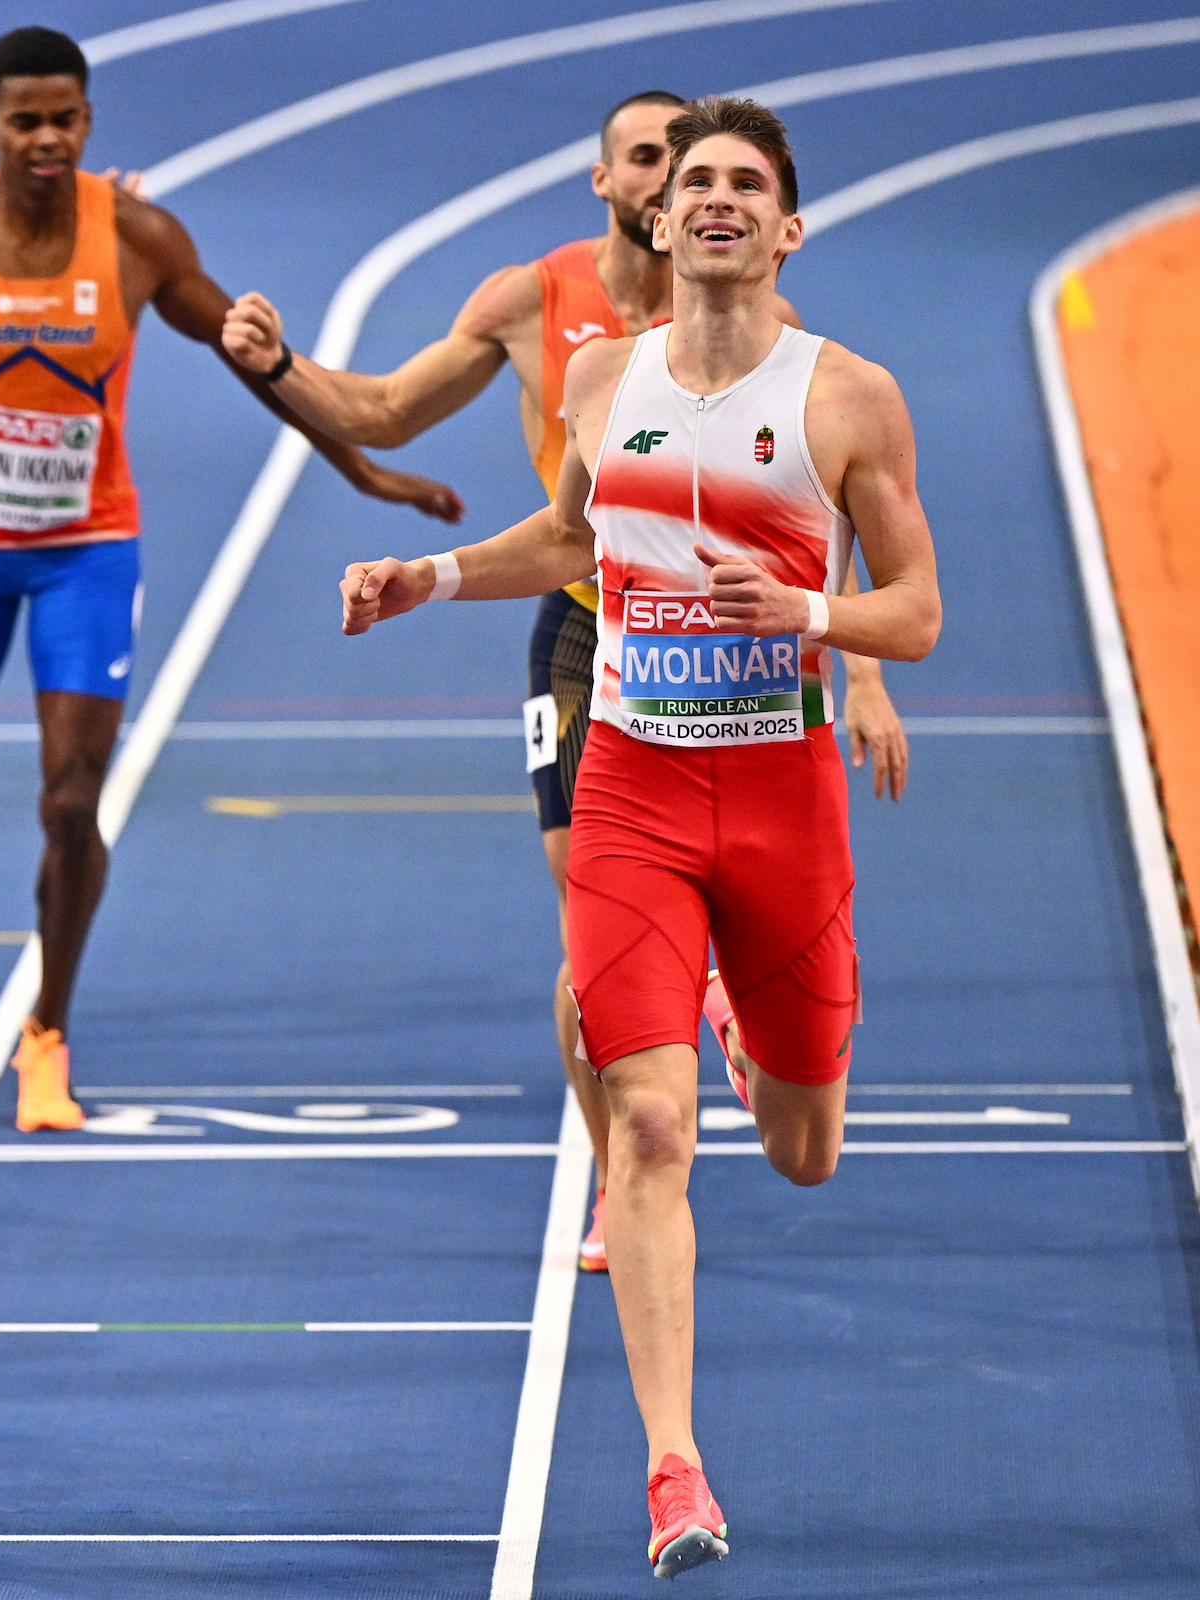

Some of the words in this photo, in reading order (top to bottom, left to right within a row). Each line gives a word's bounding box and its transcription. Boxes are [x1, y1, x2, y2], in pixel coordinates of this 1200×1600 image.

[623, 429, 669, 454] 4F
[629, 600, 716, 629] SPA
[625, 637, 796, 684] MOLNÁR
[659, 701, 663, 714] I
[667, 701, 701, 714] RUN
[630, 718, 749, 739] APELDOORN
[754, 717, 798, 736] 2025
